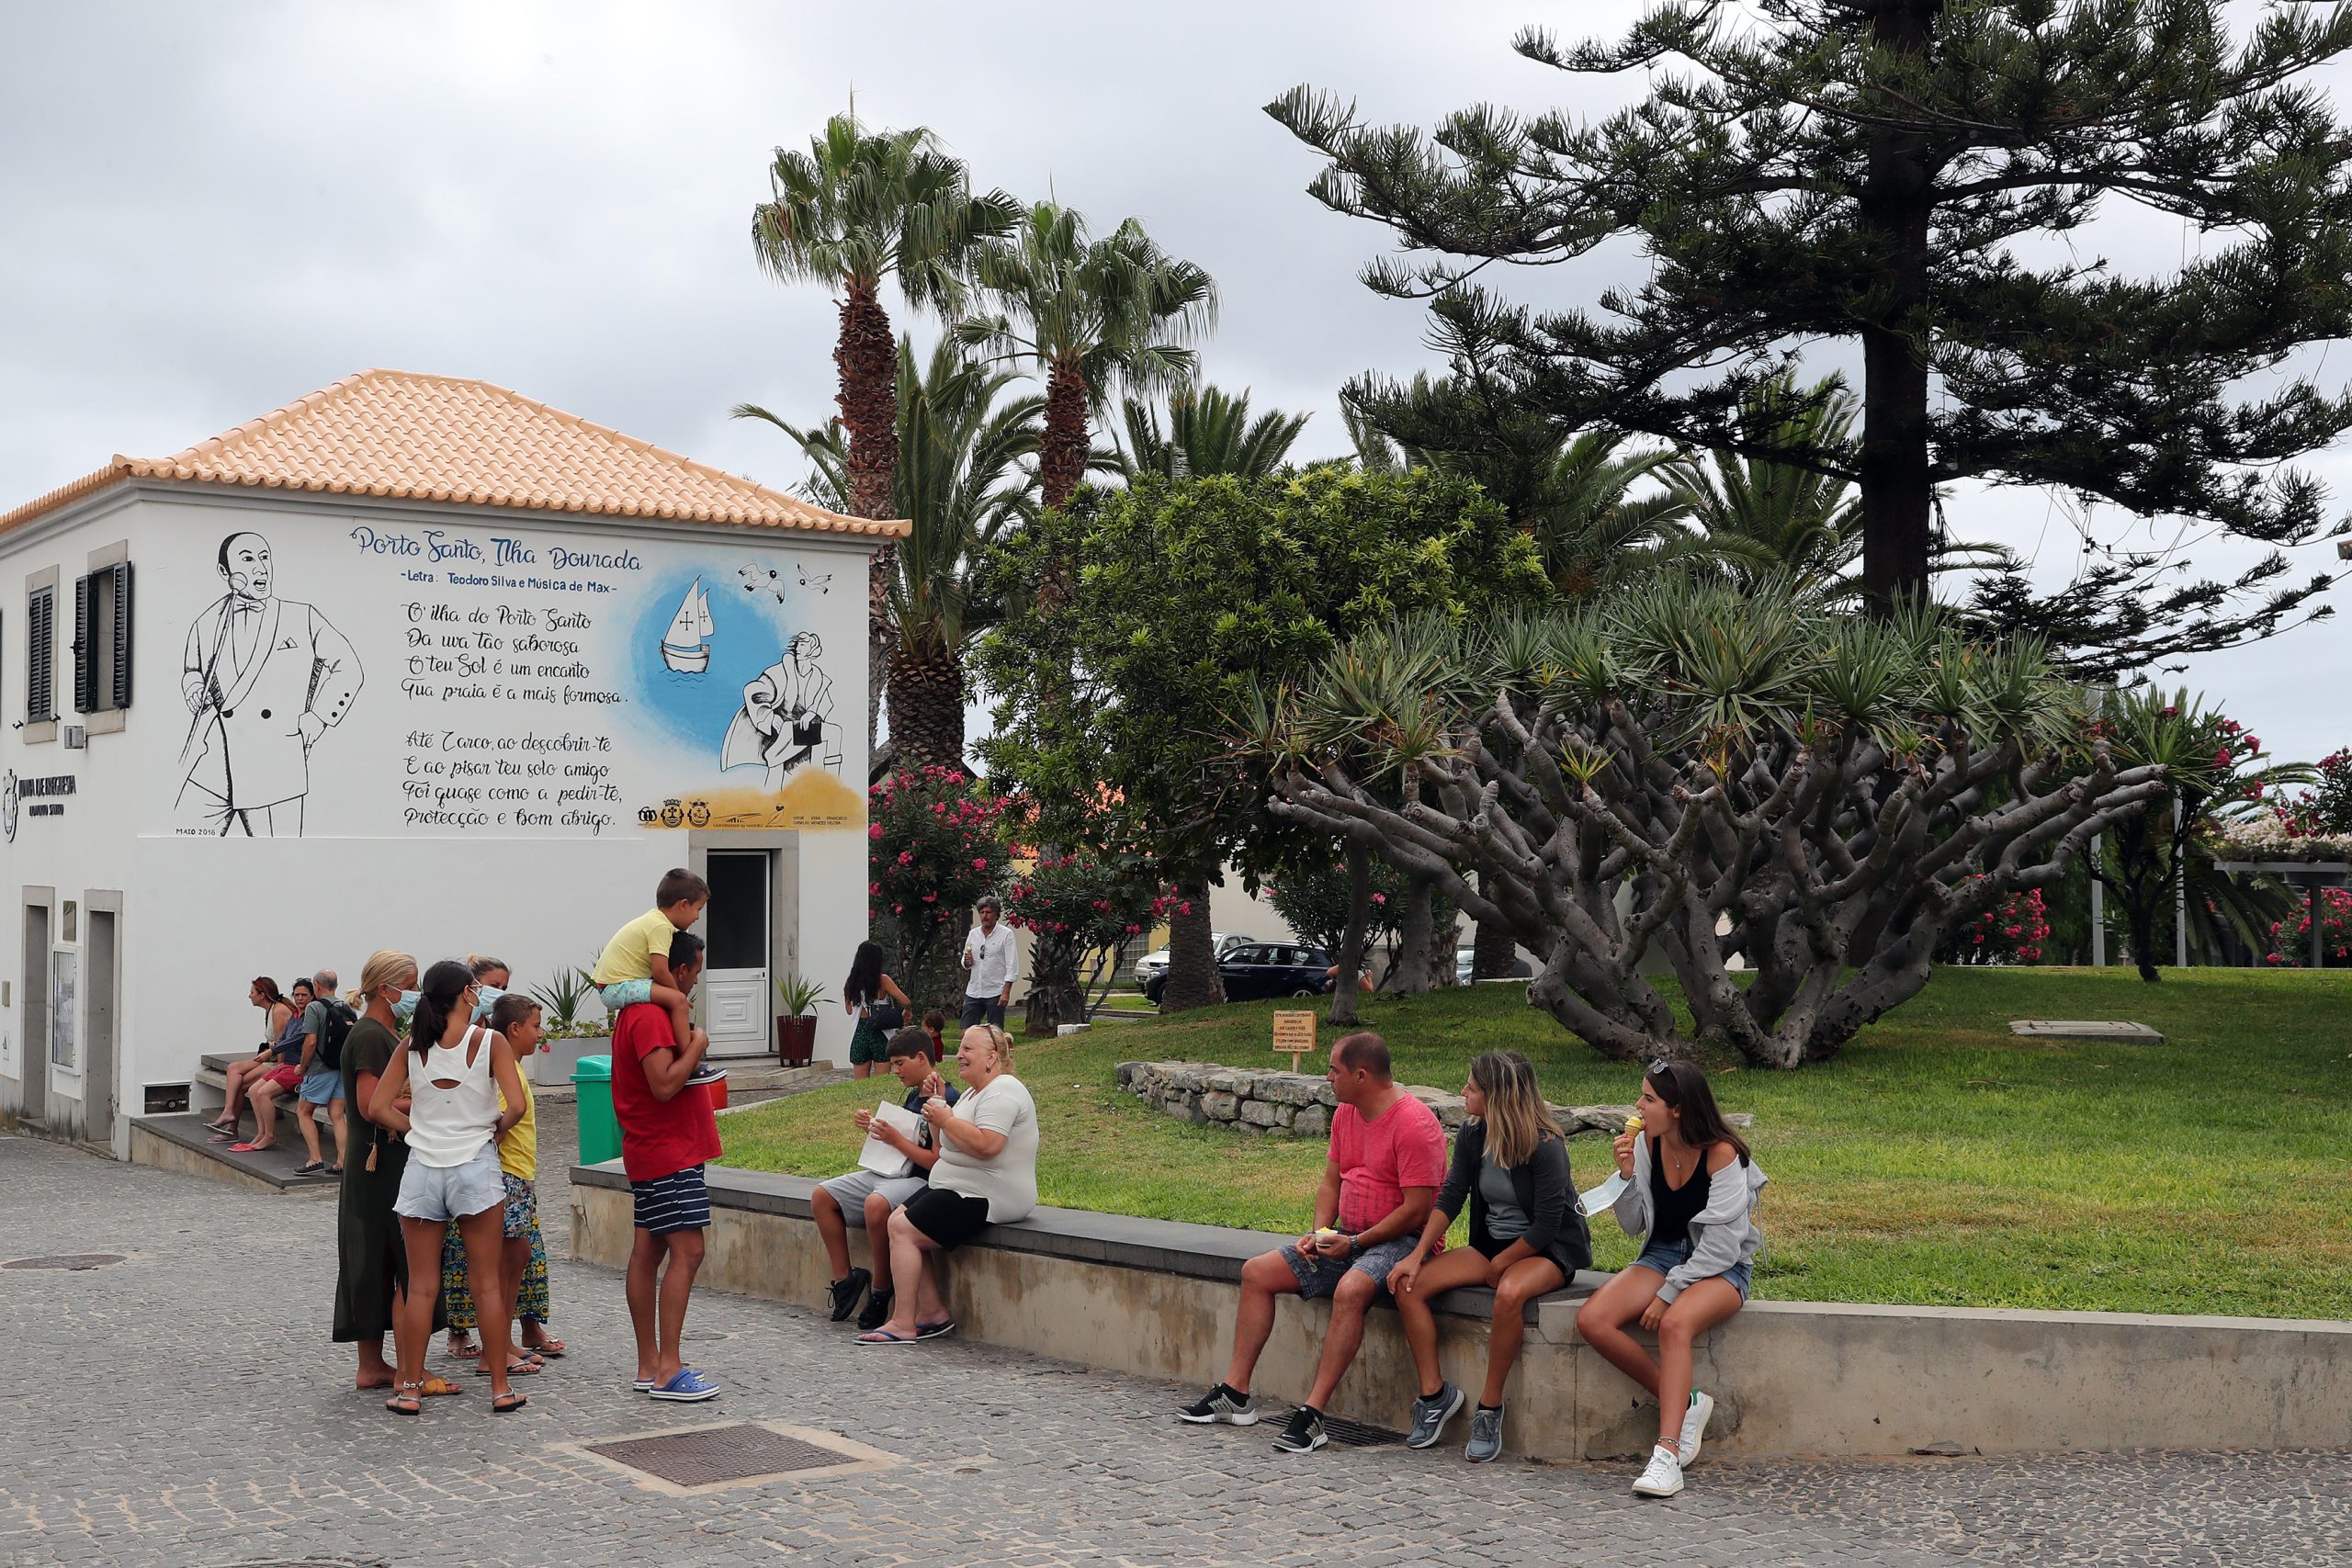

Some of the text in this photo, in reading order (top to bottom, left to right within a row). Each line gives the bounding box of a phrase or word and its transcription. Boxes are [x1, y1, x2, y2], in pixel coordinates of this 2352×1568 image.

[349, 526, 643, 570] Porto Santo, Ilha Dourada
[447, 572, 489, 586] Teodoro
[518, 580, 525, 588] e
[527, 575, 567, 591] Música
[569, 581, 582, 592] de
[430, 604, 460, 622] ilha
[468, 606, 490, 624] do
[495, 604, 536, 626] Porto
[540, 608, 592, 632] Santo
[404, 627, 433, 648] Da
[441, 635, 469, 649] uva
[512, 634, 580, 656] saborosa
[404, 653, 590, 679] O teu Sol é um encanto
[401, 678, 435, 700] Tua
[442, 683, 487, 702] praia
[506, 688, 517, 700] a
[523, 686, 557, 704] mais
[404, 730, 434, 749] Até
[497, 738, 518, 750] ao
[402, 755, 610, 785] E ao pisar teu solo amigo
[435, 787, 481, 808] quase
[488, 788, 529, 800] como
[537, 788, 548, 800] a
[404, 807, 616, 837] Protecção e bom abrigo.
